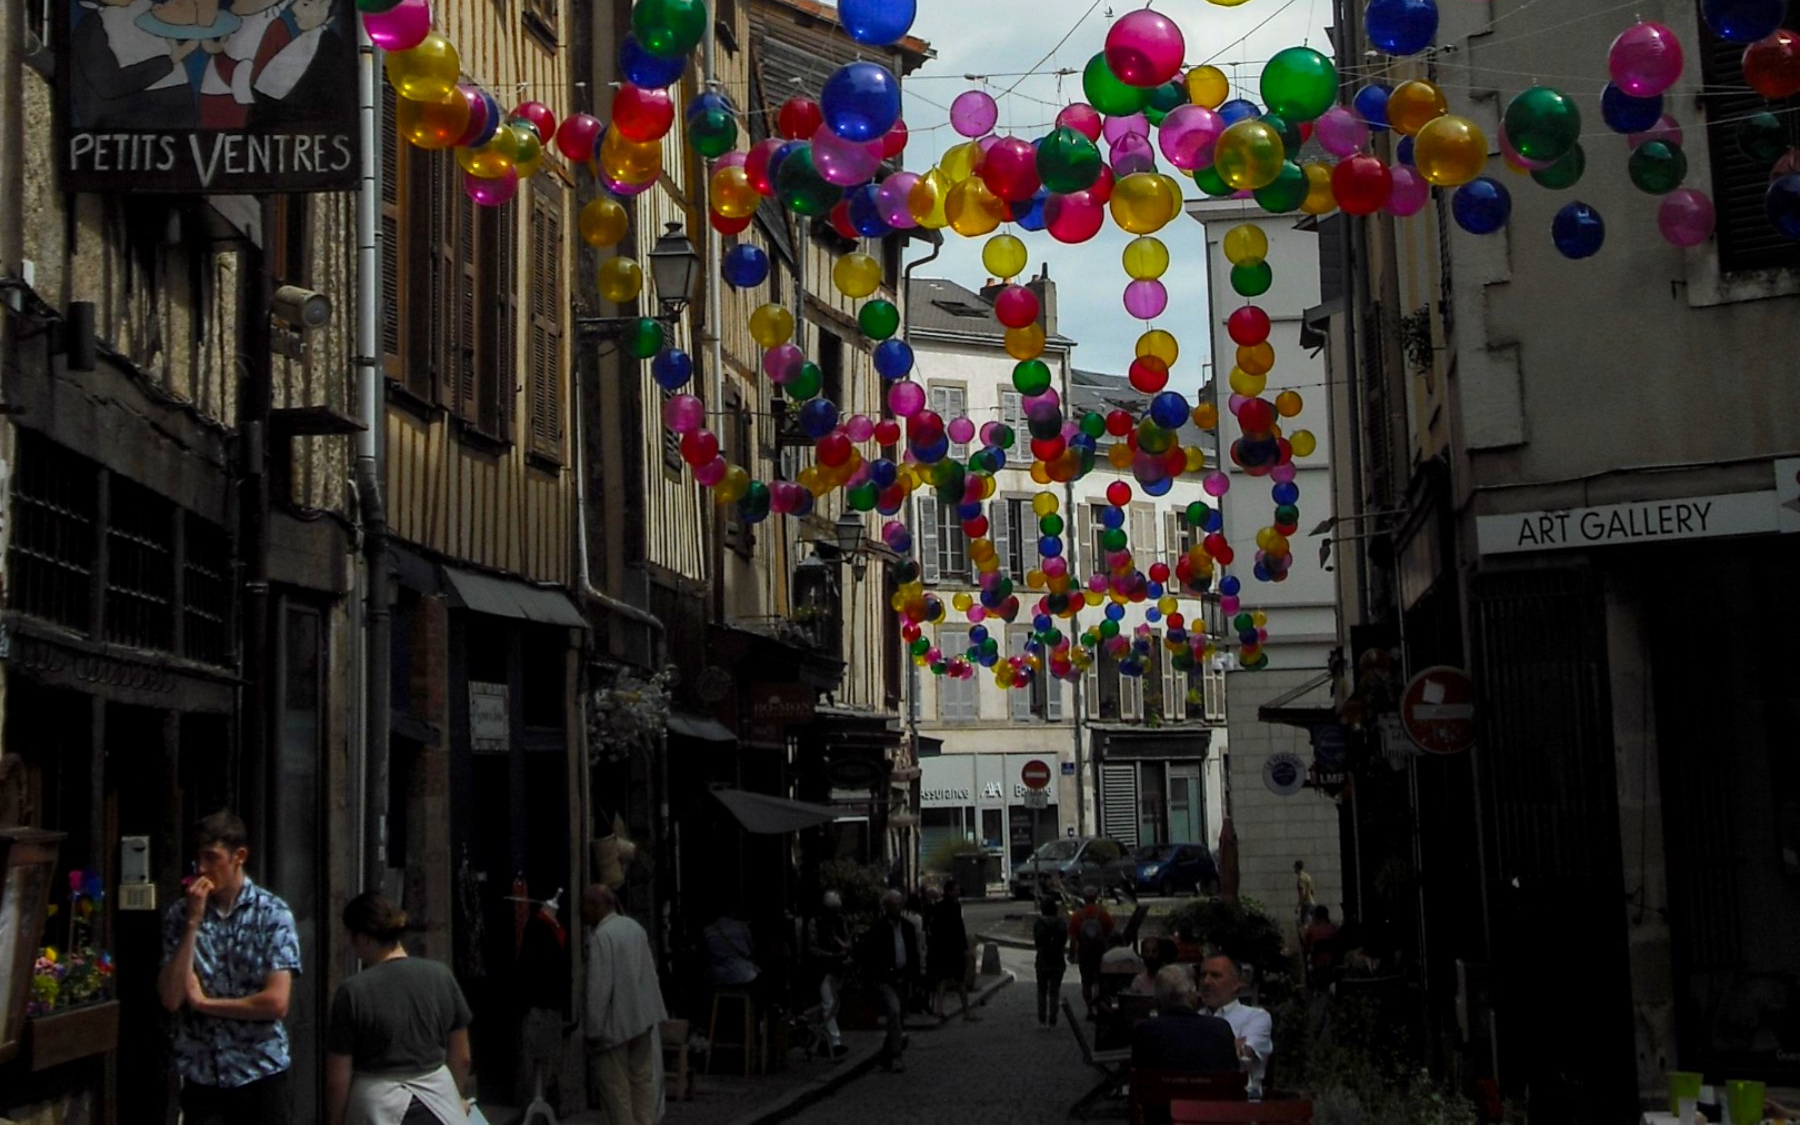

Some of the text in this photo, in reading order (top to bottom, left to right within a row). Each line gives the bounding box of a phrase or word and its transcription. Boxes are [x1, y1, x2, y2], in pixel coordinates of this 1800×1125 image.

[70, 133, 351, 187] PETITS VENTRES
[1518, 502, 1712, 546] ART GALLERY
